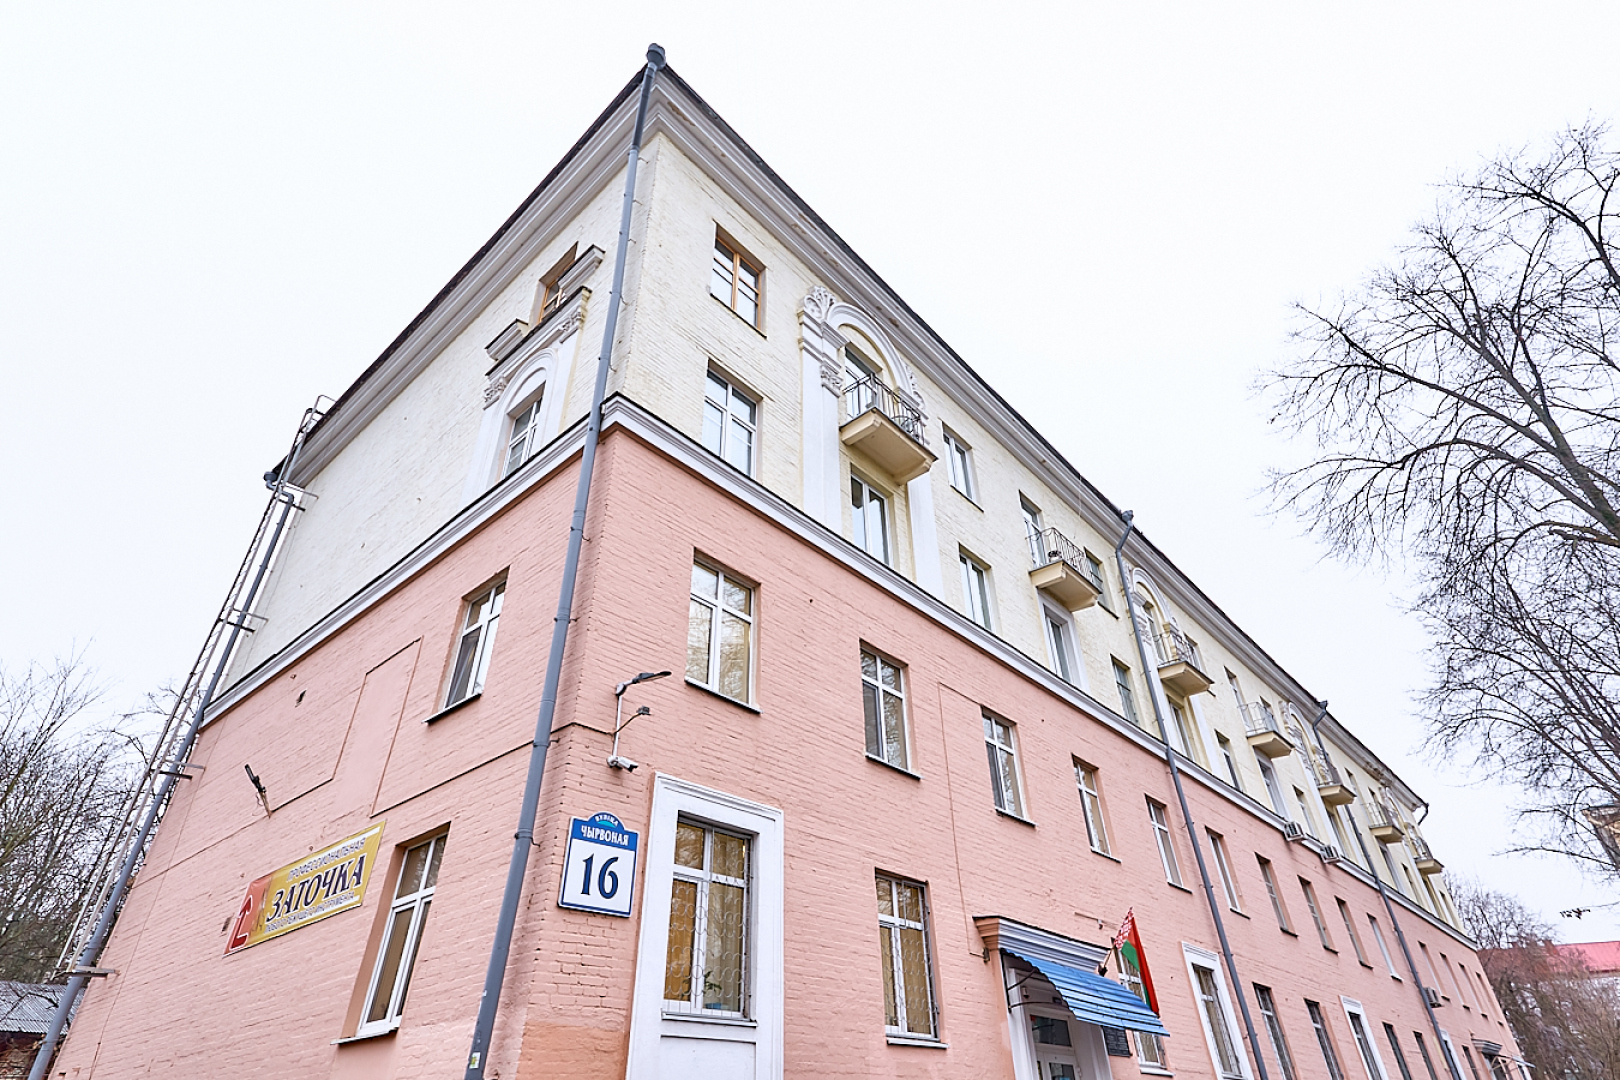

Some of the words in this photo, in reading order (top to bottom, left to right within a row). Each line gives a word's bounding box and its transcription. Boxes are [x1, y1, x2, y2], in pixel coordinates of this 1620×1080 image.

[581, 825, 629, 846] ЧЫРВОНАЯ
[286, 837, 367, 882] ПРОФЕССИОНАЛЬНАЯ
[580, 852, 619, 900] 16
[266, 854, 367, 923] ЗАТОЧКА
[315, 891, 355, 913] ИНСТРУМЕНТА
